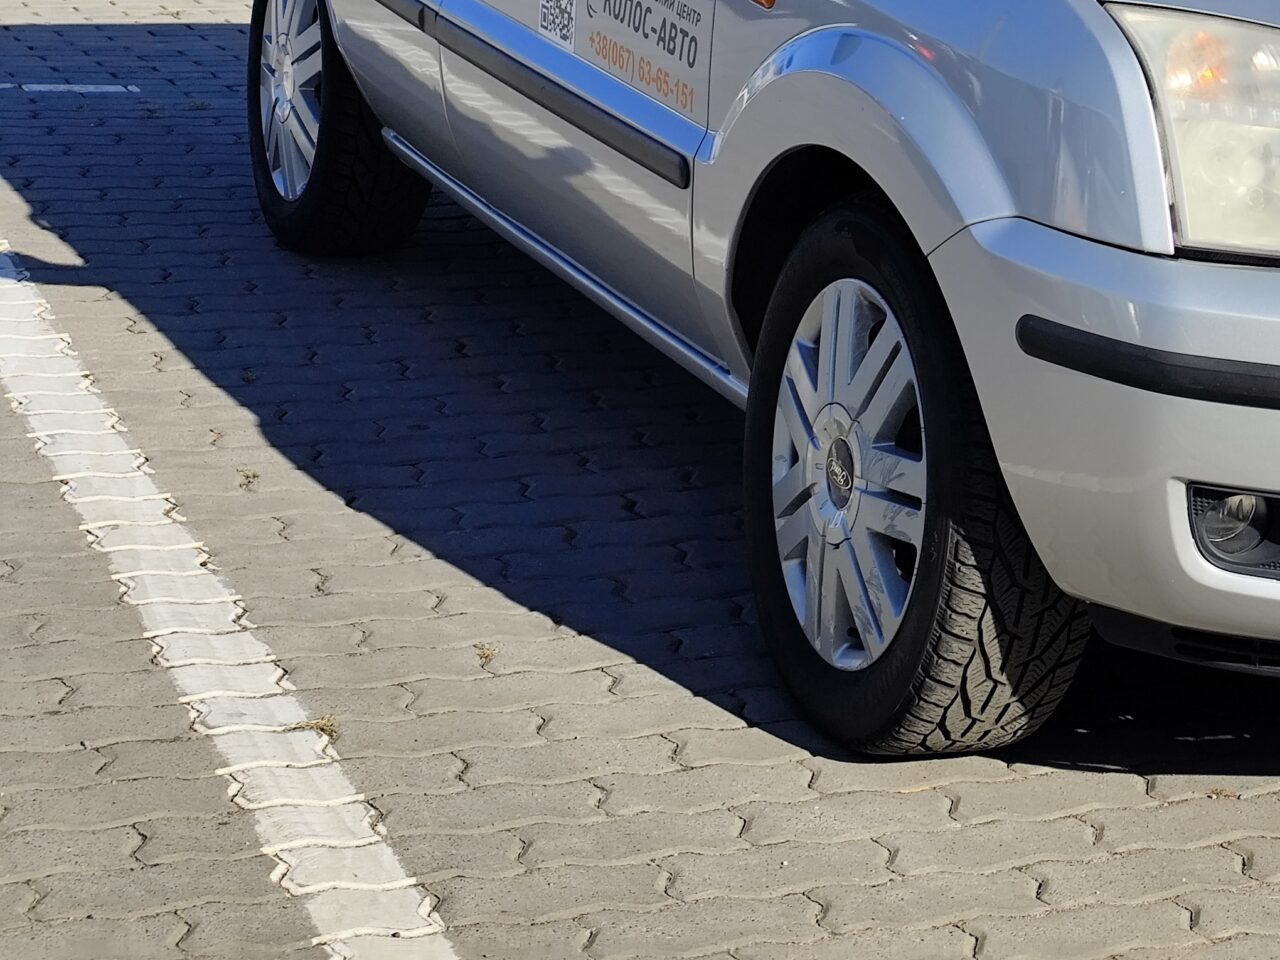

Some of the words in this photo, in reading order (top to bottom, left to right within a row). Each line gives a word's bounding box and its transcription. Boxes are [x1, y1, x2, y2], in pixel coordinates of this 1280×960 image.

[676, 1, 702, 28] ЦЕНТР
[589, 31, 635, 82] +38(067)
[638, 56, 695, 113] 63-65-151
